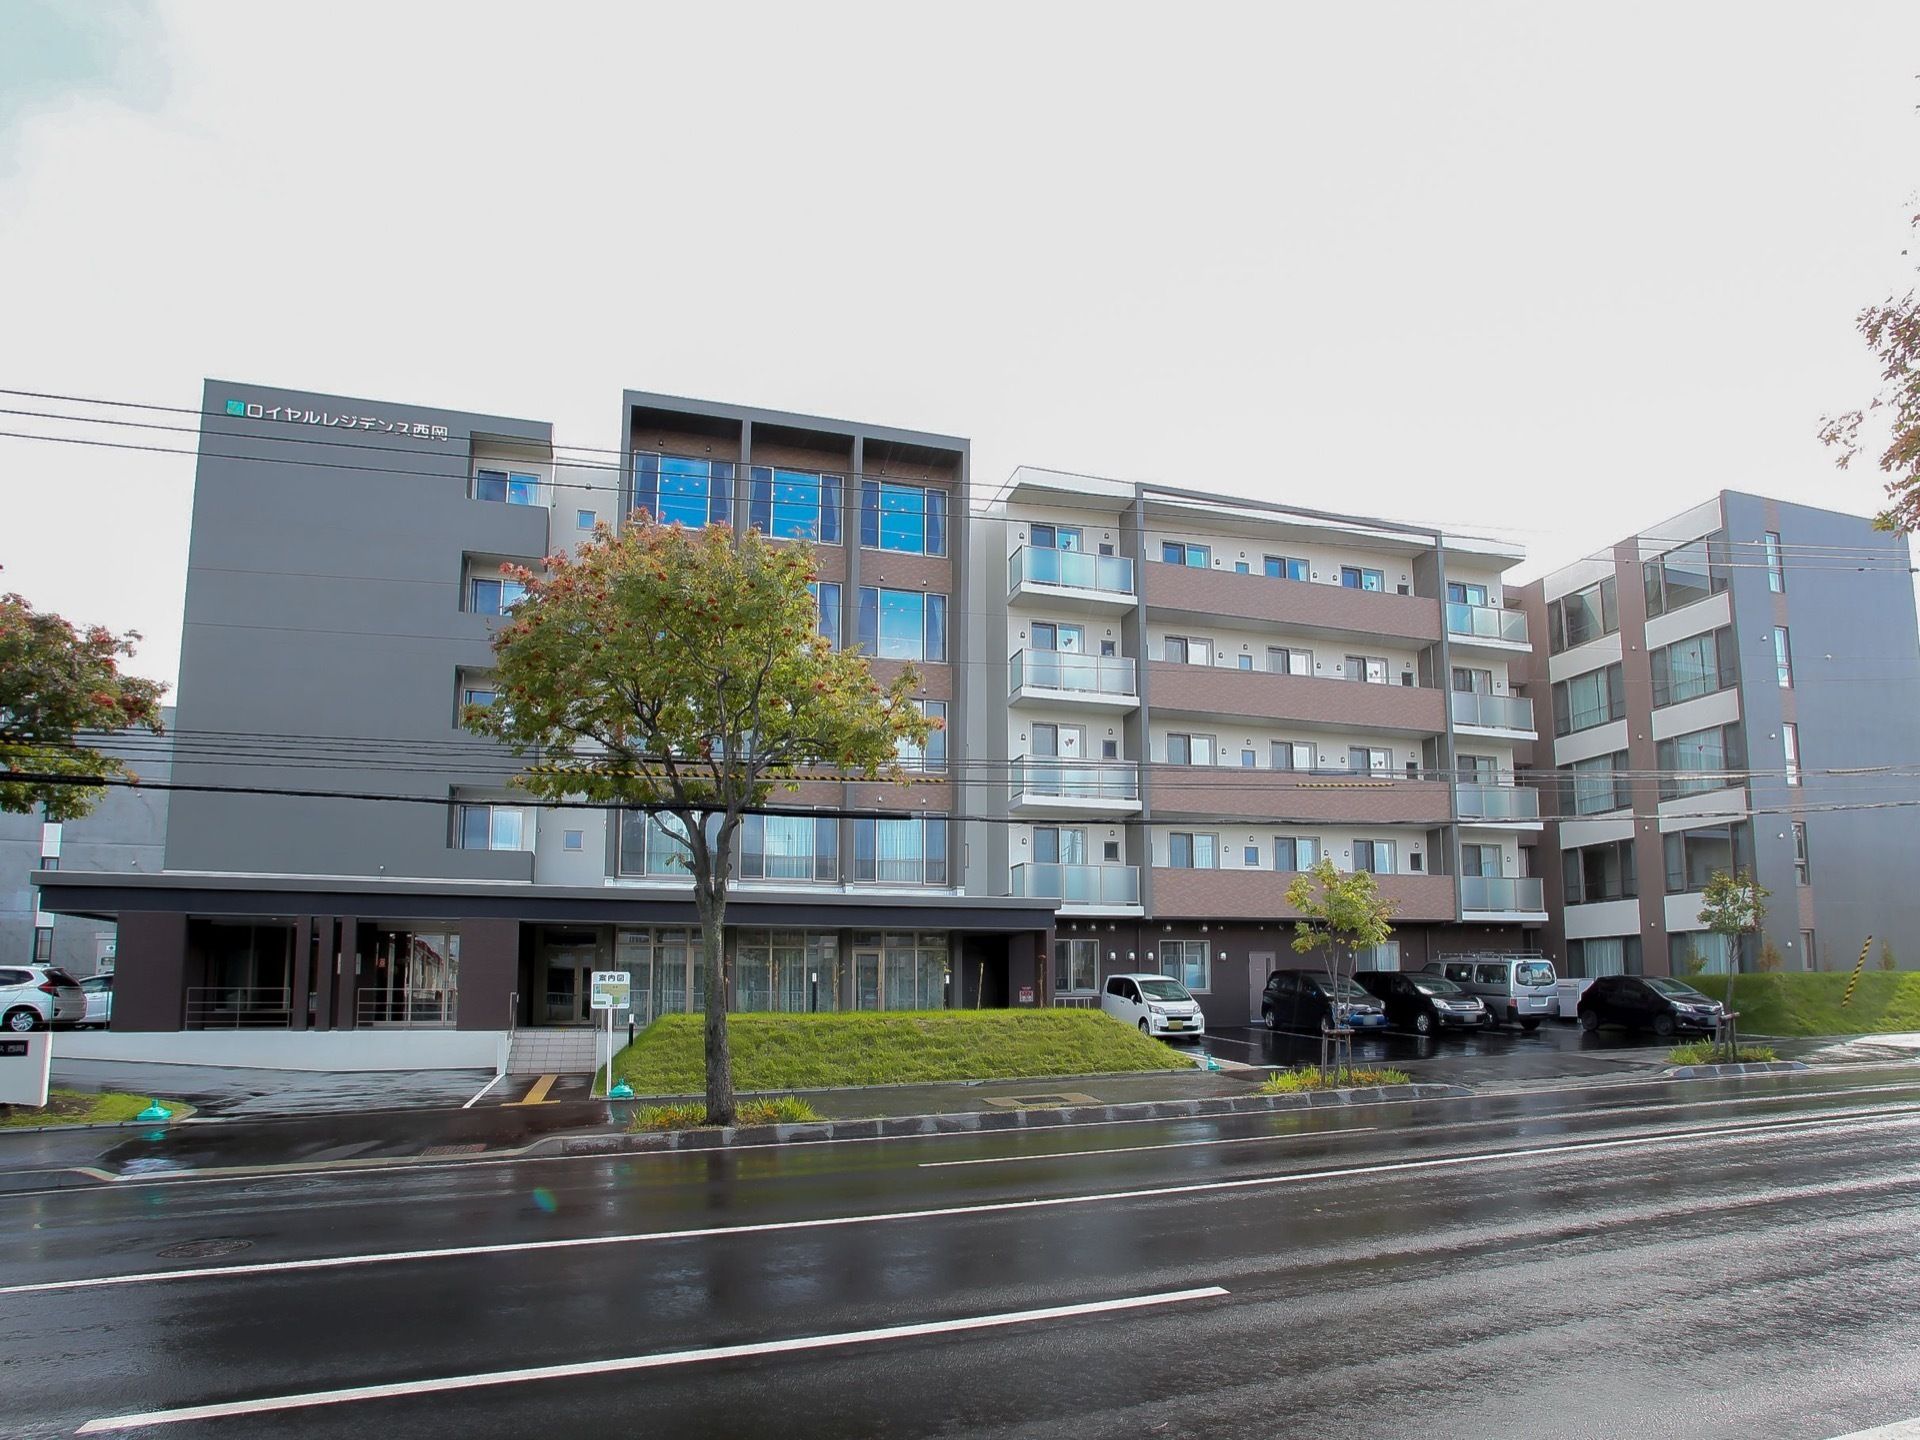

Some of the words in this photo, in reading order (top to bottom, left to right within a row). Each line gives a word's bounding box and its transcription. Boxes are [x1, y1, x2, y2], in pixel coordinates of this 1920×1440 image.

[247, 404, 448, 441] ロイヤルレジデンス西岡
[598, 974, 625, 982] 案内図
